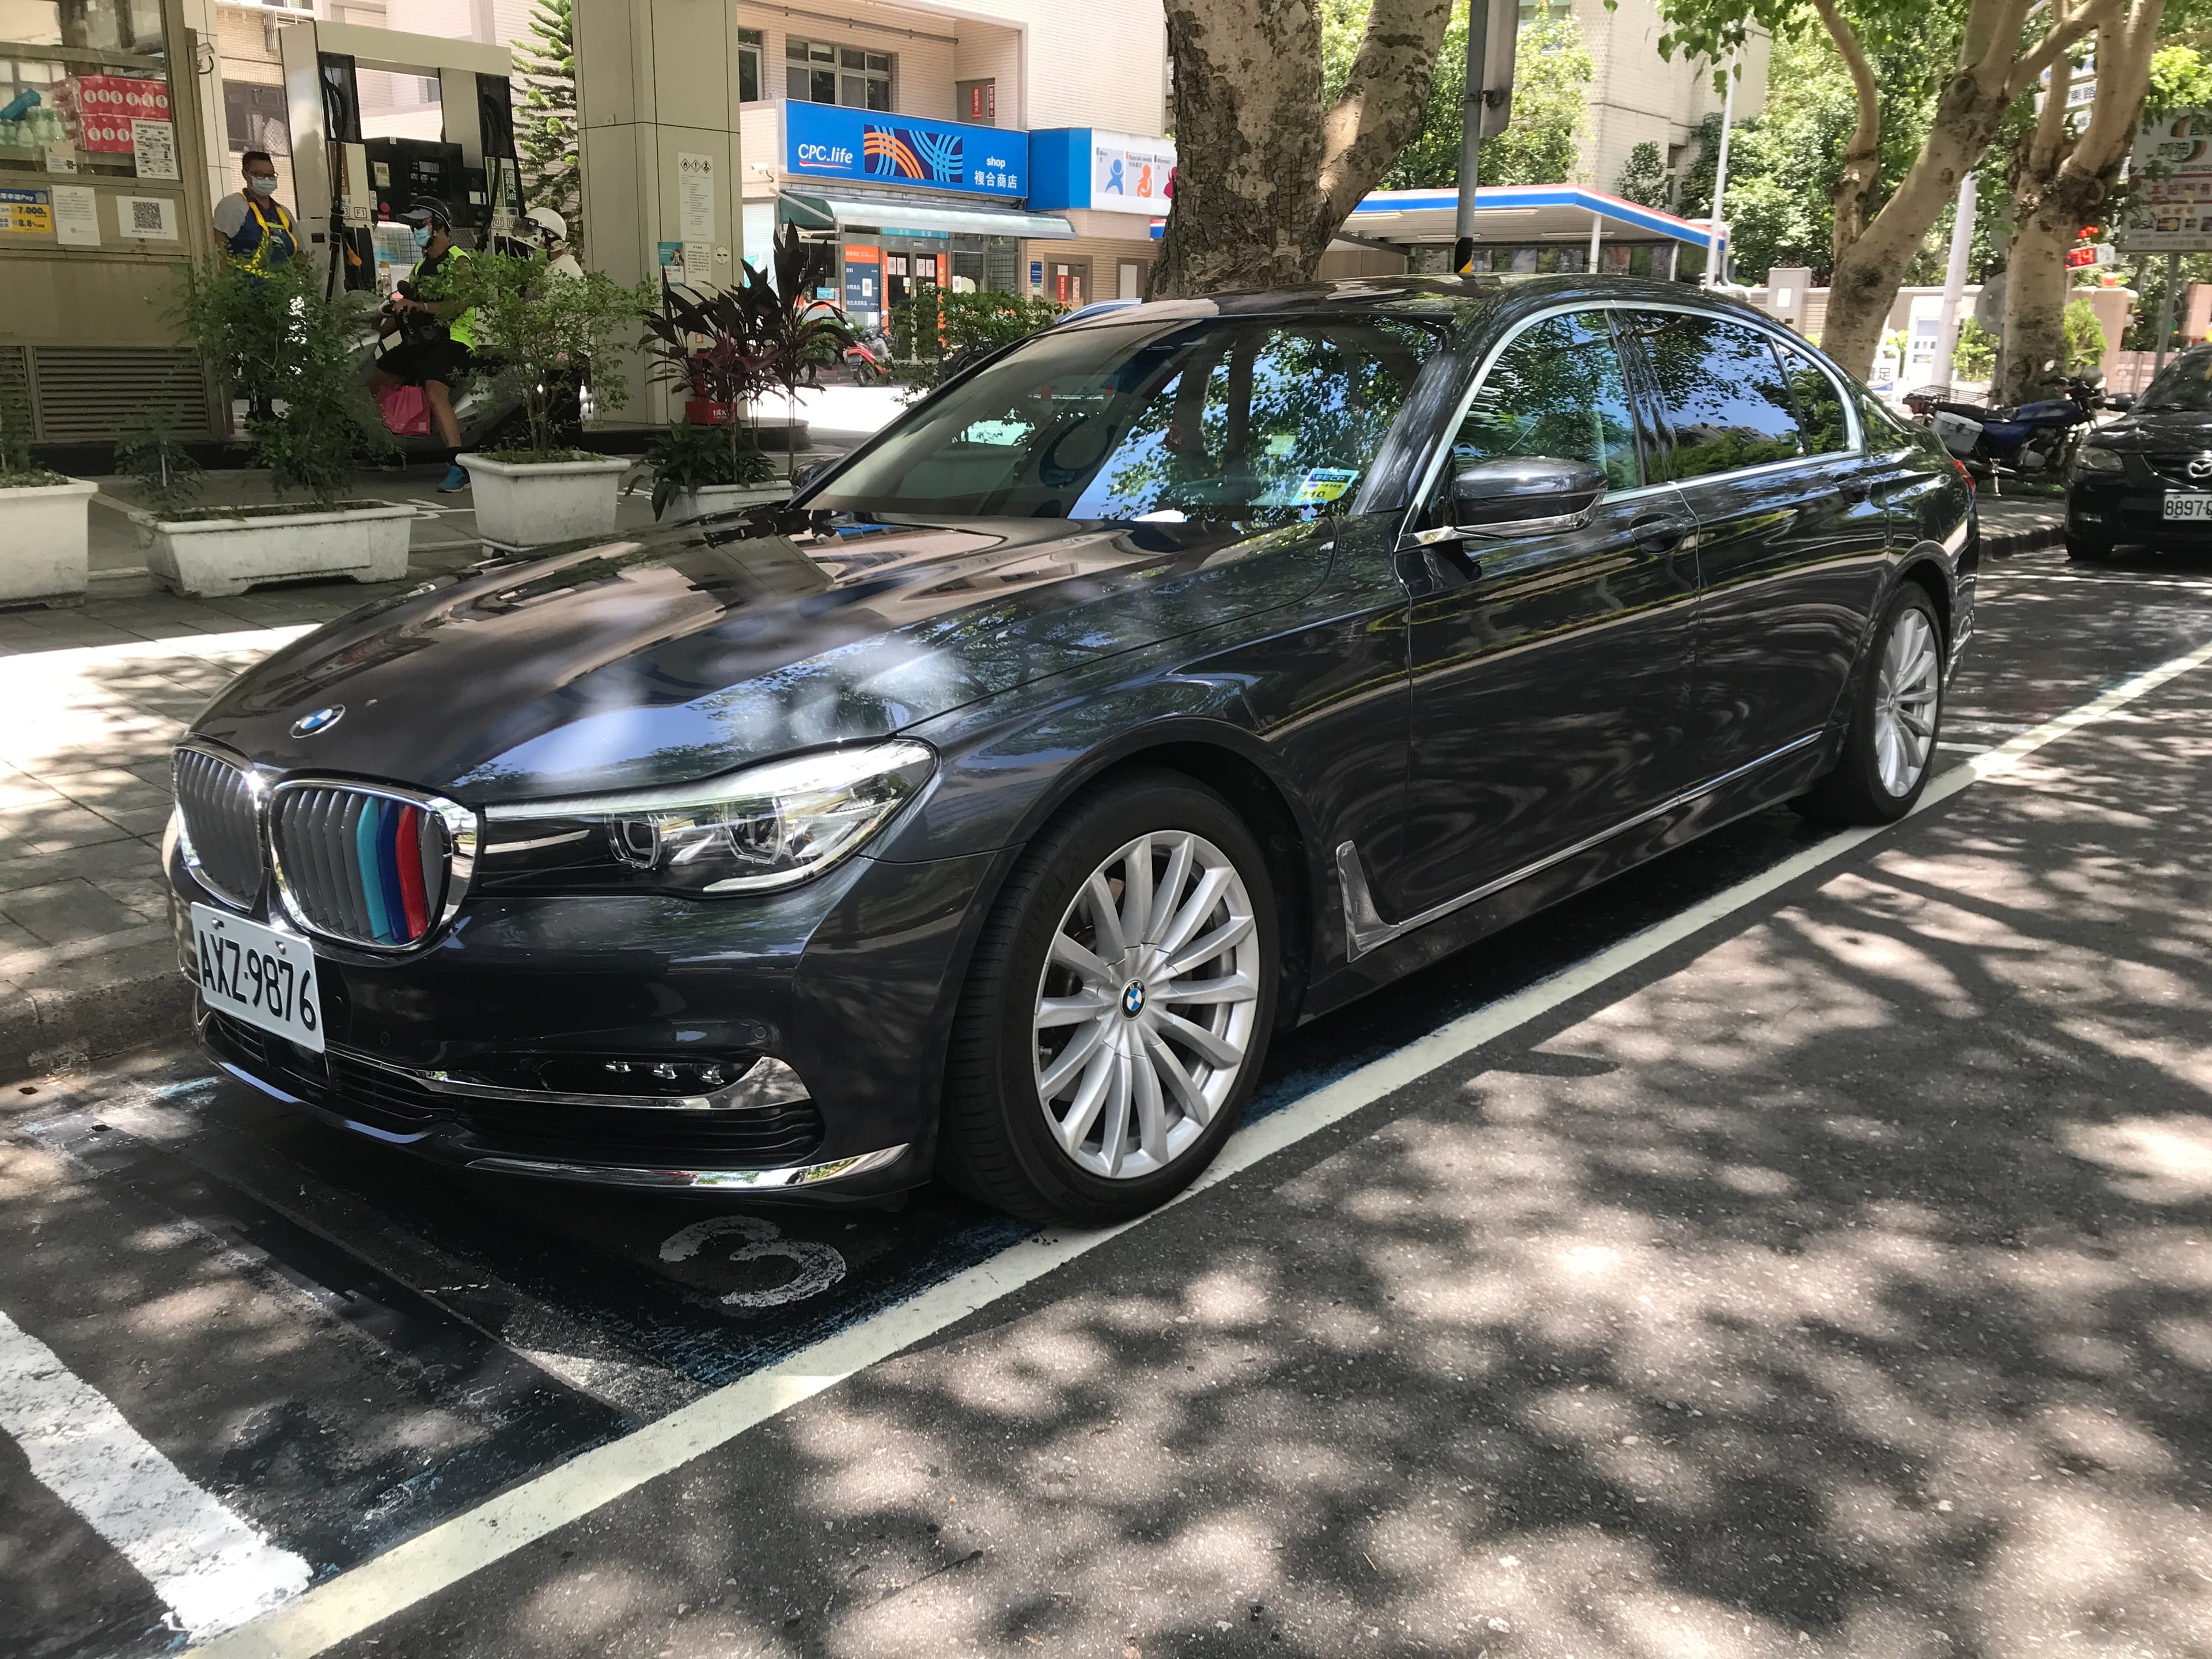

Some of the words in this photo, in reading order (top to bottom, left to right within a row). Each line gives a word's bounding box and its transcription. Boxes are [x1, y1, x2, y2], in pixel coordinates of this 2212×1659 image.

[798, 143, 853, 164] CPC.life
[986, 156, 1006, 170] shop
[974, 170, 1018, 190] 複合商店
[199, 929, 317, 1032] AXZ-9876
